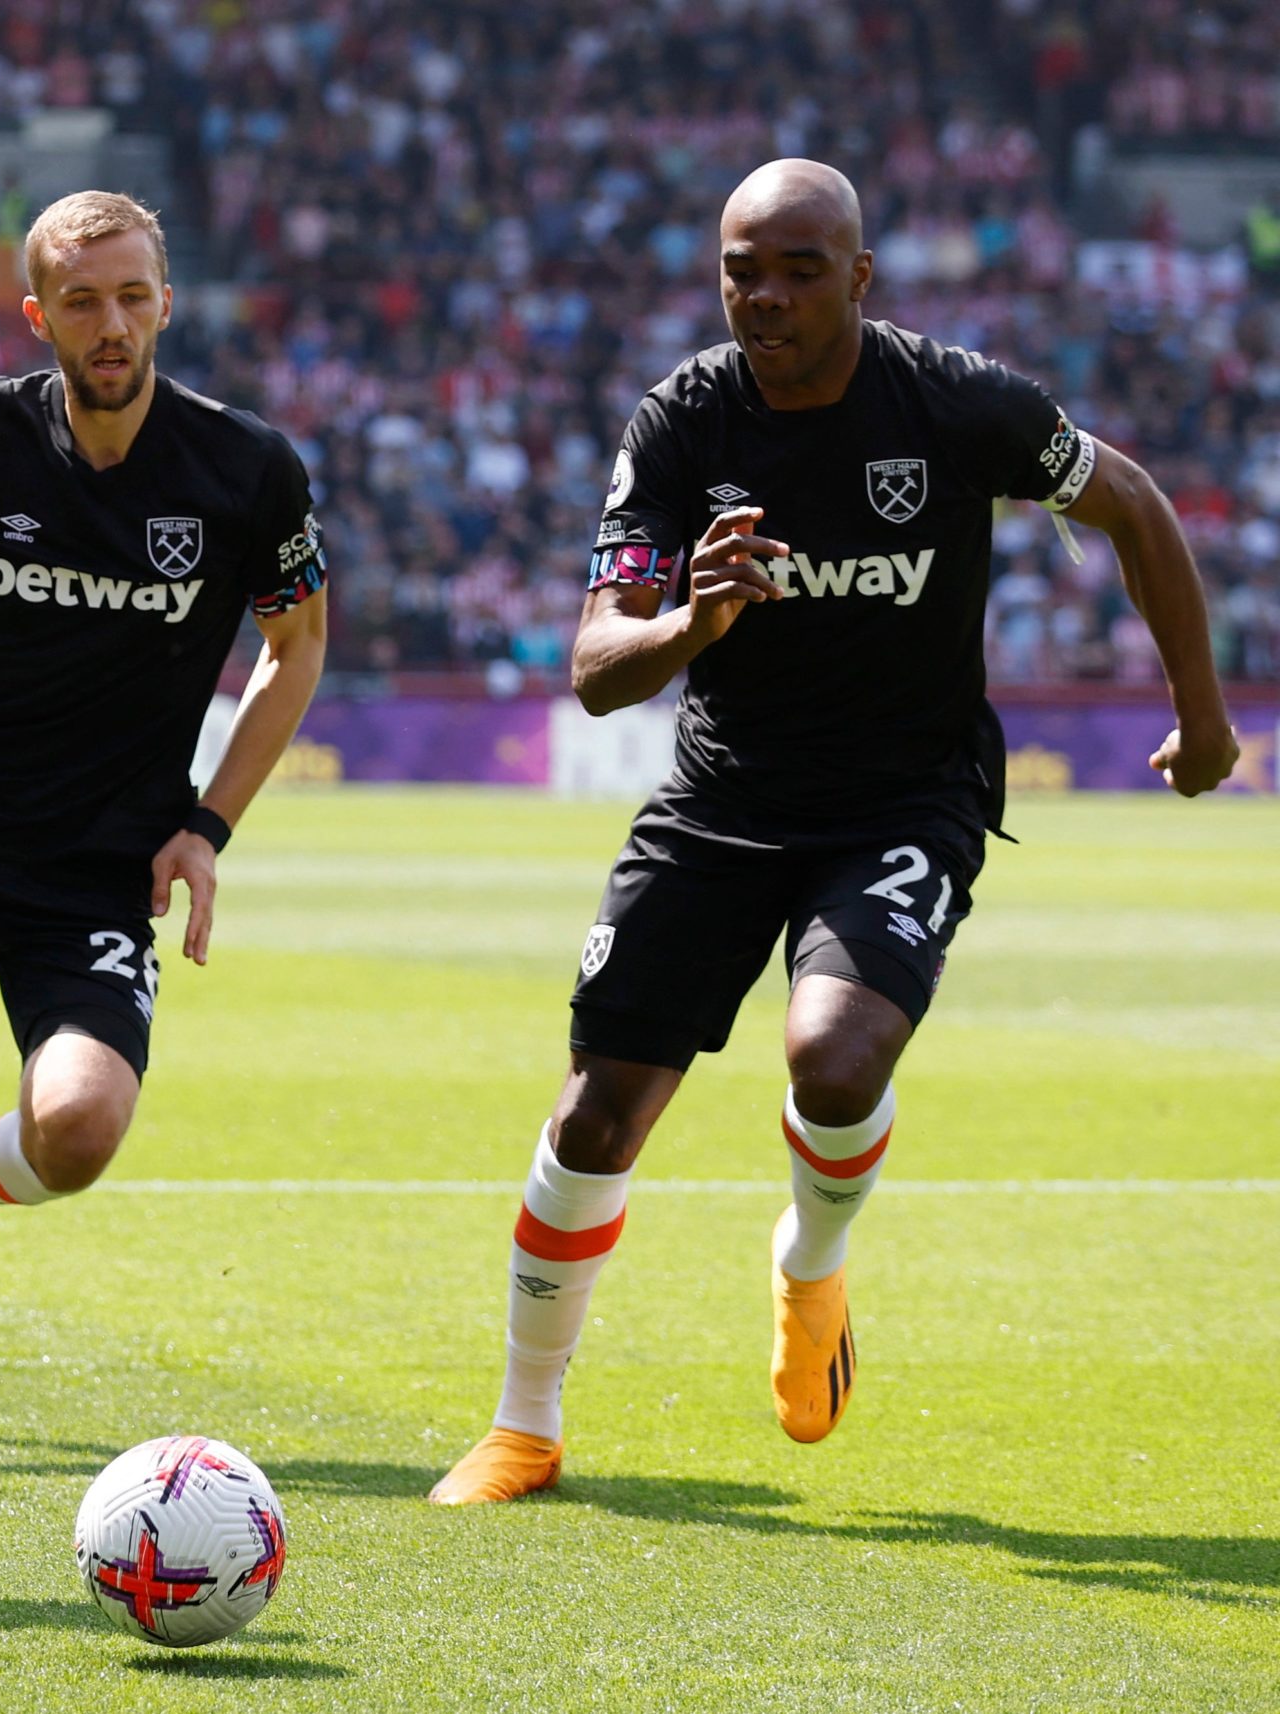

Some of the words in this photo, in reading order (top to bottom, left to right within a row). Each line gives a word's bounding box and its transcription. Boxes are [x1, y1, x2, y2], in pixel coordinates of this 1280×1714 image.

[3, 530, 35, 544] umbro
[862, 845, 952, 934] 21
[887, 923, 918, 947] umbro
